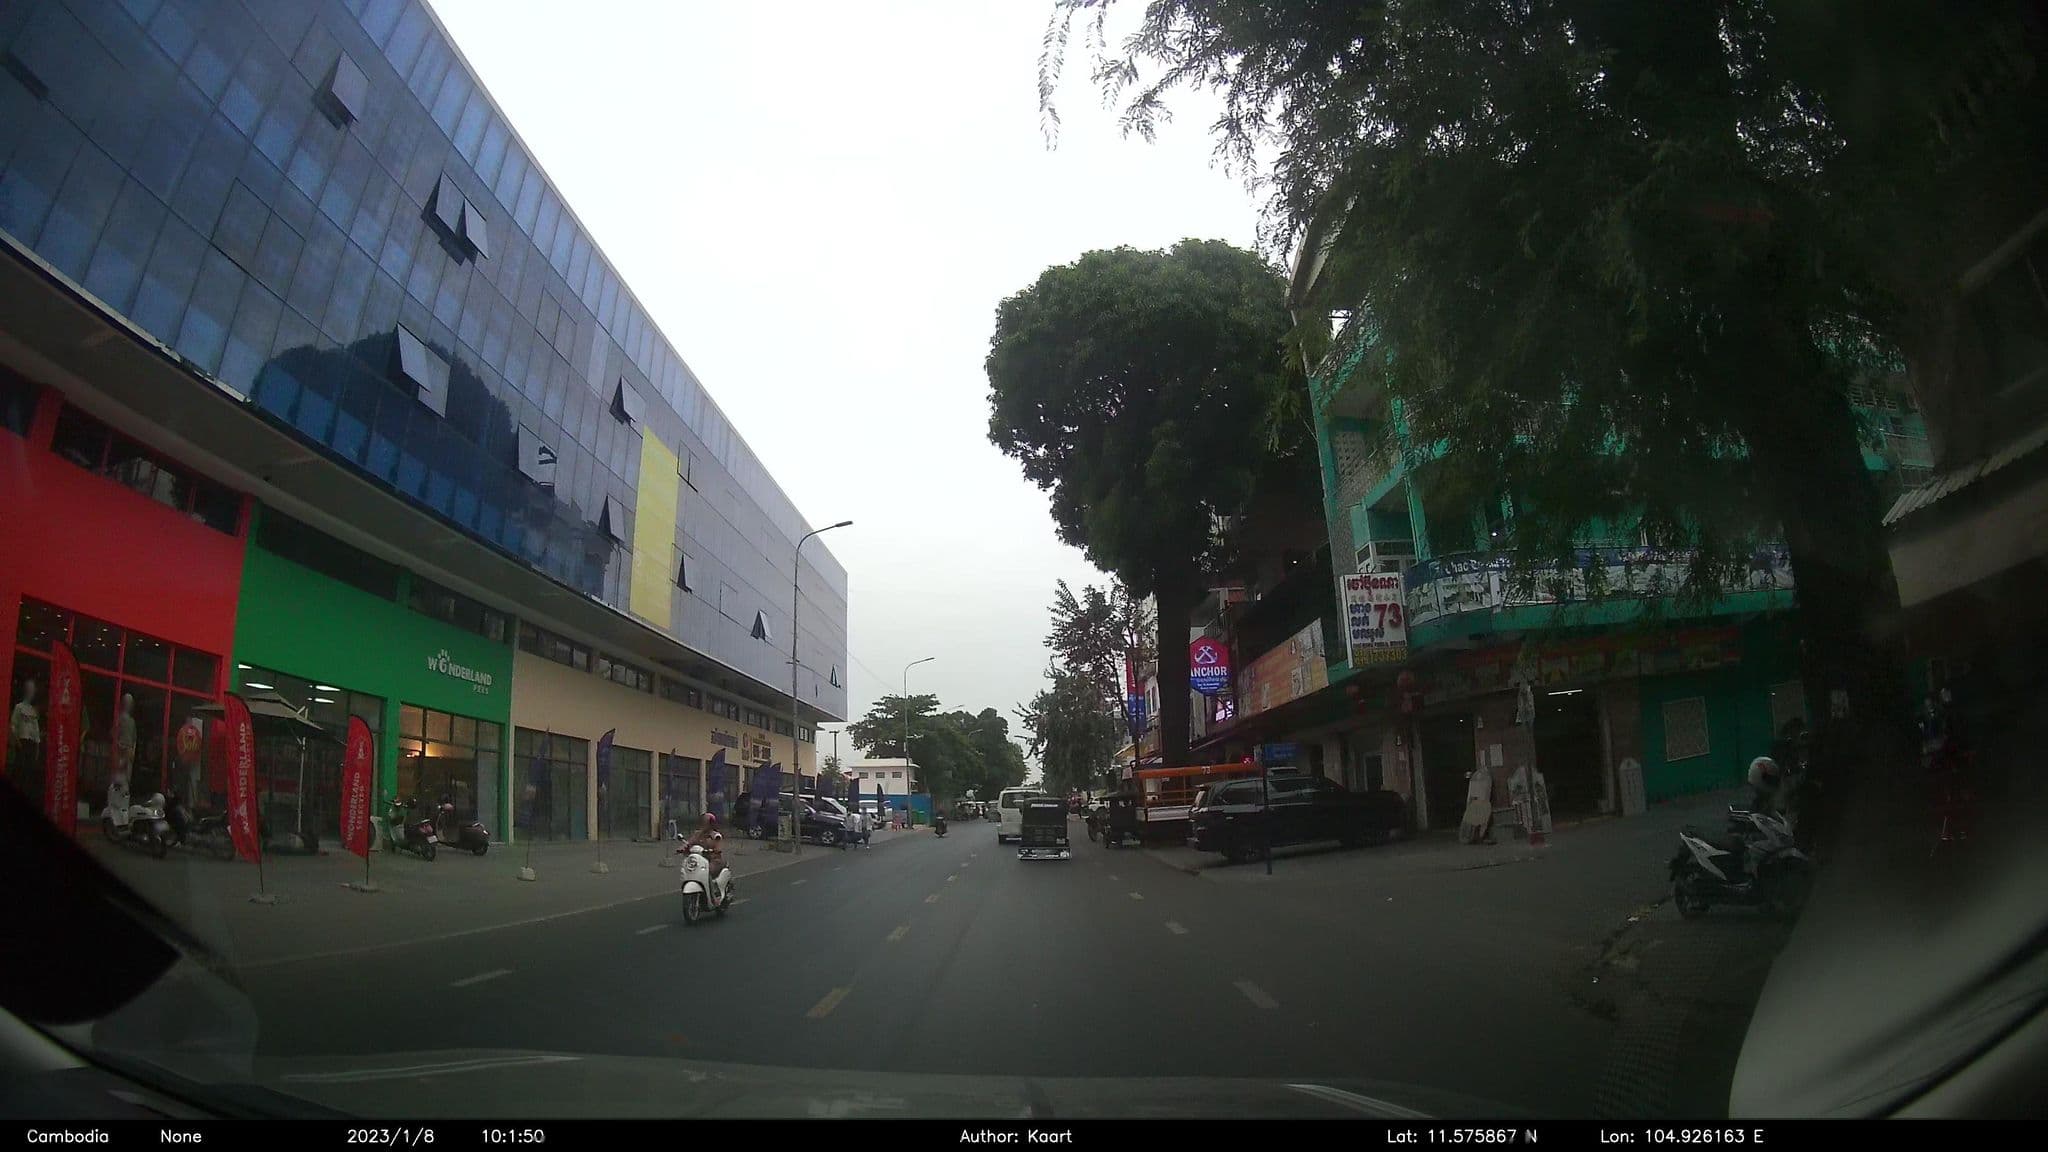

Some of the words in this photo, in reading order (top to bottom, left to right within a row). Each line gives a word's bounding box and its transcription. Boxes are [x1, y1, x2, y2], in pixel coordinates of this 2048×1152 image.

[1373, 602, 1403, 629] 73
[427, 655, 493, 686] WONDERLAND
[346, 772, 361, 841] WONDERLAND
